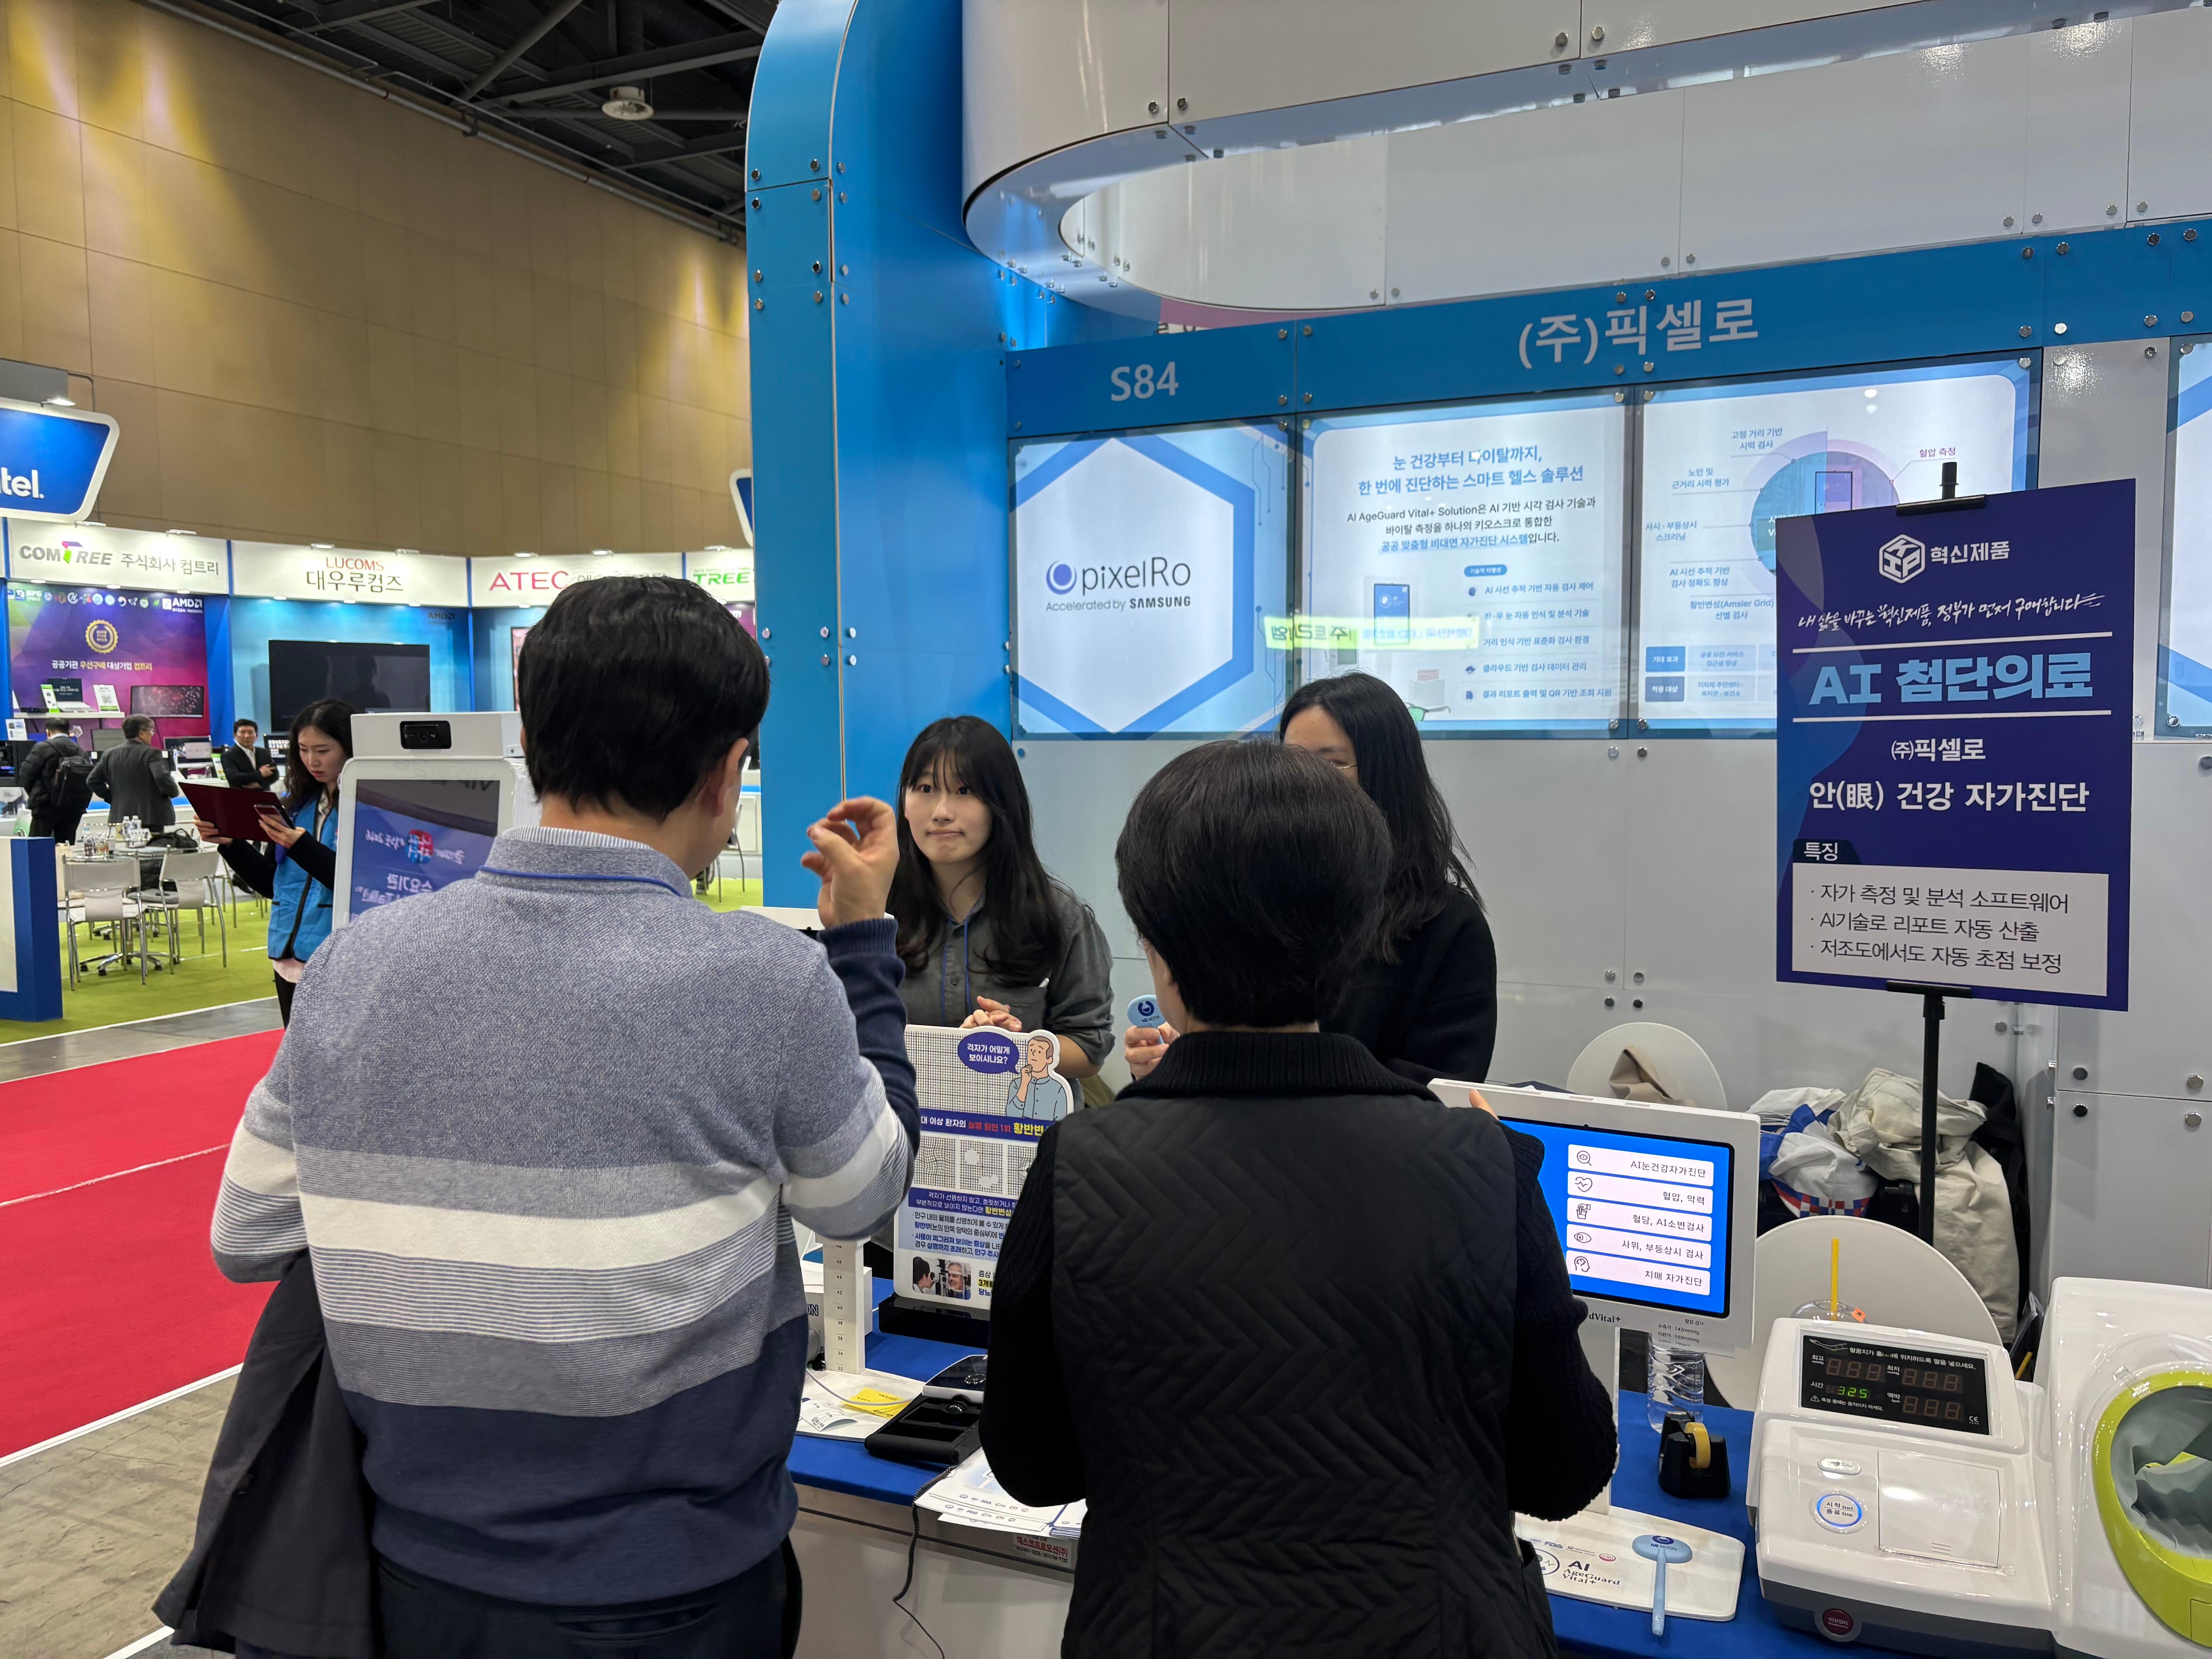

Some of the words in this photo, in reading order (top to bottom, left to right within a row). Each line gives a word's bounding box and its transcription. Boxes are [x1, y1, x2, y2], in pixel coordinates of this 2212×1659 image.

[1519, 298, 1759, 370] (주)픽셀로
[1110, 362, 1179, 401] S84
[1749, 429, 1764, 438] 거리
[1767, 428, 1782, 436] 기반
[1740, 442, 1755, 450] 시력
[1758, 440, 1773, 448] 검사
[1393, 457, 1406, 471] 눈
[1410, 450, 1464, 469] 건강부터
[1468, 445, 1542, 465] 바이탈까지,
[0, 467, 45, 499] tel.
[1358, 481, 1371, 495] 한
[1376, 478, 1401, 494] 번에
[1406, 476, 1459, 492] 진단하는
[1463, 471, 1504, 488] 스마트
[1509, 469, 1536, 485] 헬스
[1541, 466, 1584, 483] 솔루션
[1347, 514, 1357, 522] AI
[1359, 511, 1405, 523] AgeGuard
[1408, 508, 1435, 518] Vital+
[1438, 504, 1486, 517] Solution은
[1489, 505, 1499, 513] AI
[1502, 502, 1521, 512] 기반
[1523, 501, 1542, 511] 시각
[1546, 500, 1564, 510] 검사
[1567, 497, 1595, 508] 기술과
[1386, 524, 1412, 535] 바이탈
[1415, 522, 1442, 534] 측정을
[1445, 520, 1472, 532] 하나의
[1475, 518, 1522, 530] 키오스크로
[1524, 516, 1552, 527] 통합한
[1382, 541, 1398, 551] 공공
[1401, 539, 1428, 551] 맞춤형
[1431, 538, 1458, 549] 비대면
[1460, 535, 1497, 547] 자가진단
[1500, 532, 1559, 544] 시스템입니다.
[1931, 540, 2010, 563] 혁신제품
[19, 541, 112, 565] COMTREE
[121, 553, 176, 571] 주식회사
[180, 560, 218, 575] 컴트리
[326, 557, 384, 571] LUCOMS
[307, 571, 403, 592] 대우루컴즈
[489, 570, 570, 591] ATEC
[693, 572, 750, 586] TREE
[1082, 557, 1191, 596] pixelRo
[1528, 584, 1542, 592] 기반
[1544, 584, 1559, 592] 자동
[1561, 583, 1576, 591] 검사
[1578, 582, 1593, 591] 제어
[1046, 599, 1111, 611] Accelerated
[1113, 599, 1125, 611] by
[1130, 596, 1191, 609] SAMSUNG
[1844, 610, 1874, 629] 바꾸는
[1937, 601, 1975, 624] 정부가
[1979, 602, 2010, 618] 먼저
[1484, 638, 1498, 646] 거리
[1500, 638, 1514, 646] 인식
[1558, 636, 1572, 644] 검사
[1531, 663, 1545, 672] 검사
[1547, 663, 1569, 671] 데이터
[1572, 662, 1586, 671] 관리
[1809, 664, 1882, 705] AI
[1897, 652, 2093, 703] 첨단의료
[1810, 780, 1884, 809] 안(眼)
[1897, 782, 1954, 809] 건강
[1965, 782, 2090, 812] 자가진단
[1803, 842, 1839, 862] 특징
[1821, 884, 1856, 903] 자가
[1860, 884, 1896, 905] 측정
[1903, 887, 1920, 906] 및
[1926, 889, 1964, 908] 분석
[1970, 891, 2069, 914] 소프트웨어
[1820, 912, 1887, 931] AI기술로
[1894, 915, 1949, 934] 리포트
[1954, 919, 1993, 939] 자동
[1999, 921, 2039, 942] 산출
[1821, 939, 1926, 962] 저조도에서도
[1932, 946, 1970, 967] 자동
[1975, 950, 2014, 970] 초점
[2020, 952, 2061, 974] 보정
[967, 1043, 988, 1053] 격자가
[989, 1045, 1010, 1055] 어떻게
[969, 1054, 1008, 1064] 보이시나요?
[930, 1117, 943, 1125] 이상
[946, 1118, 966, 1128] 환자의
[1013, 1123, 1044, 1136] 황반변
[1631, 1161, 1706, 1178] AI눈건강자가진단
[1687, 1195, 1705, 1205] 악력
[1656, 1218, 1705, 1233] AI소변검사
[1622, 1240, 1642, 1251] 사위,
[1646, 1243, 1681, 1256] 부등상시
[1686, 1249, 1704, 1260] 검사
[1645, 1270, 1662, 1280] 치매
[1666, 1273, 1702, 1286] 자가진단
[1568, 1560, 1590, 1572] AI
[1563, 1569, 1620, 1585] AgeGuard
